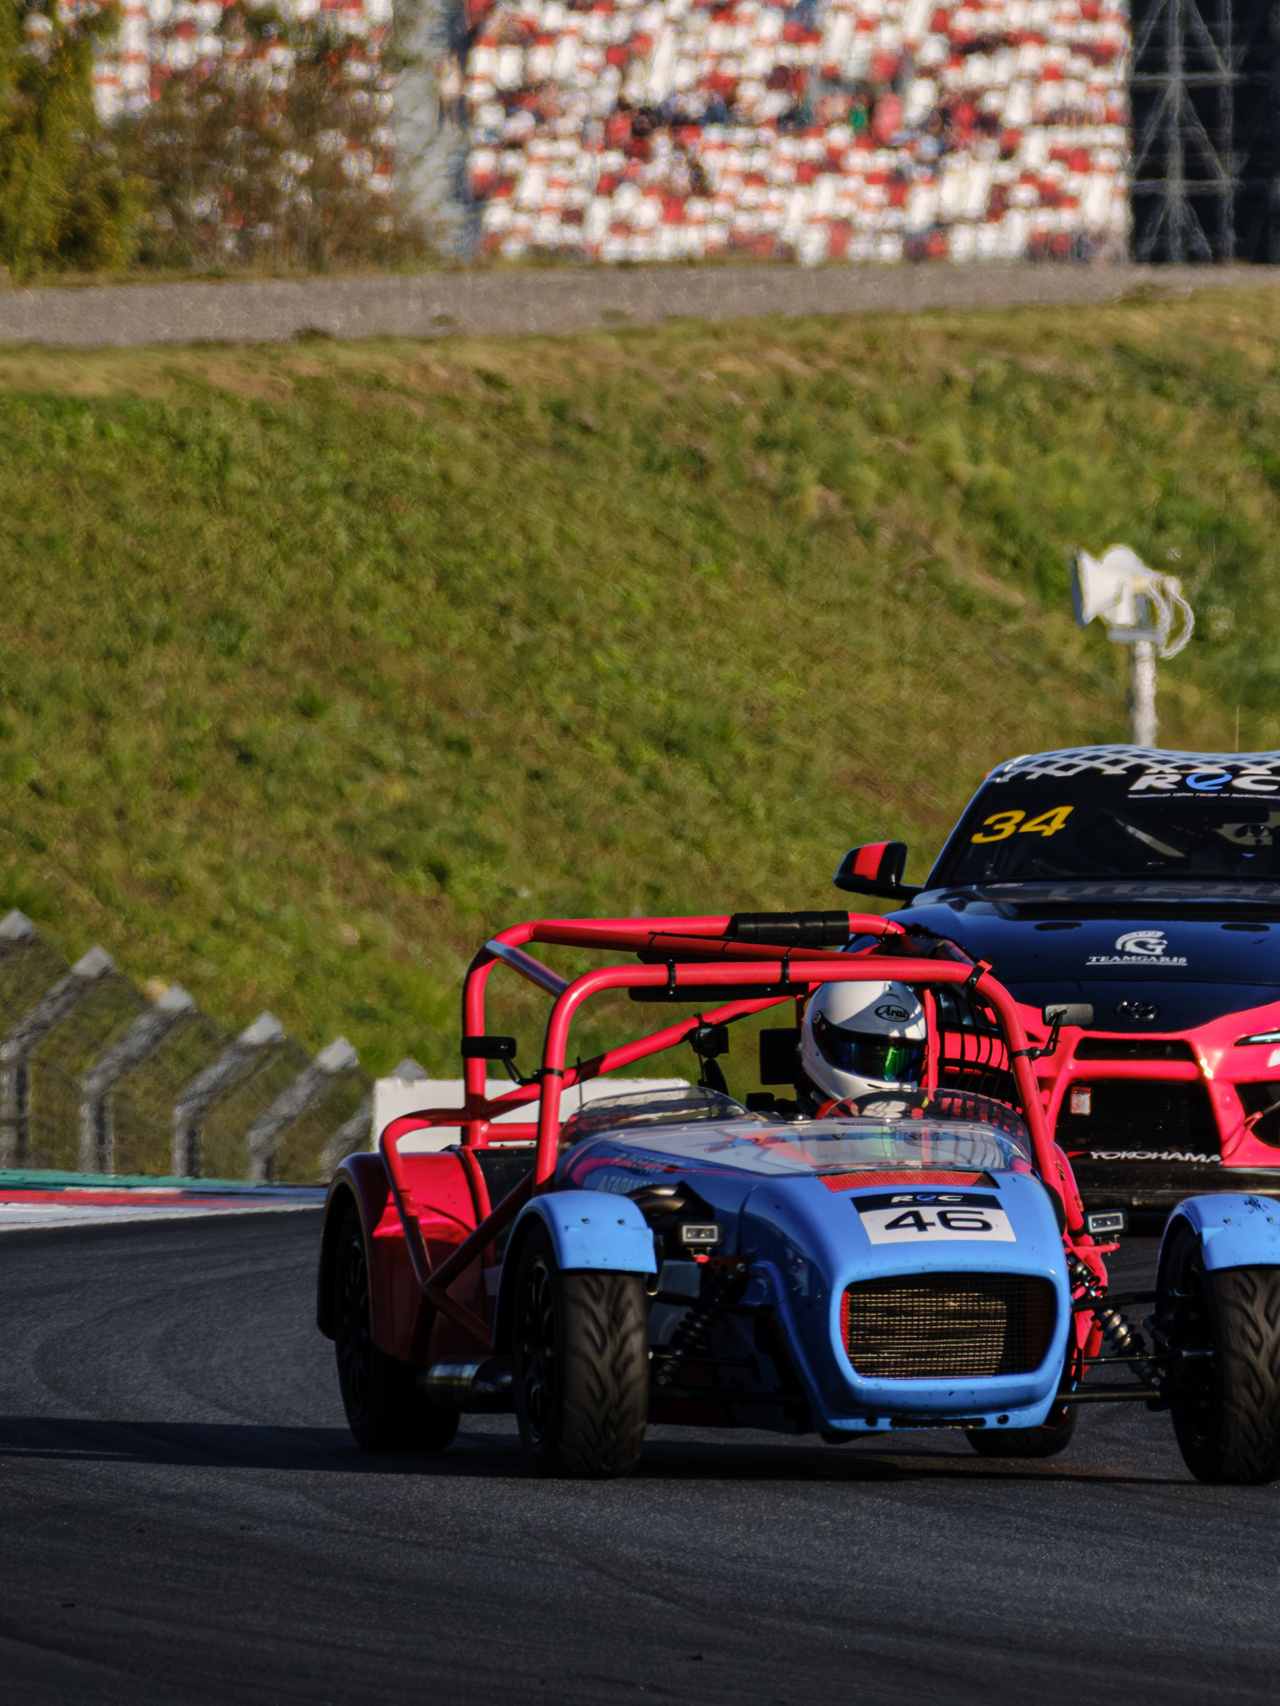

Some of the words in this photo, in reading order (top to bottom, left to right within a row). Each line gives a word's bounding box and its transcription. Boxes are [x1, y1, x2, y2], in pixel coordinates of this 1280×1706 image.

[971, 805, 1074, 844] 34
[879, 1005, 907, 1019] Arai
[1090, 1151, 1223, 1165] YOKOHAMA
[884, 1210, 993, 1232] 46
